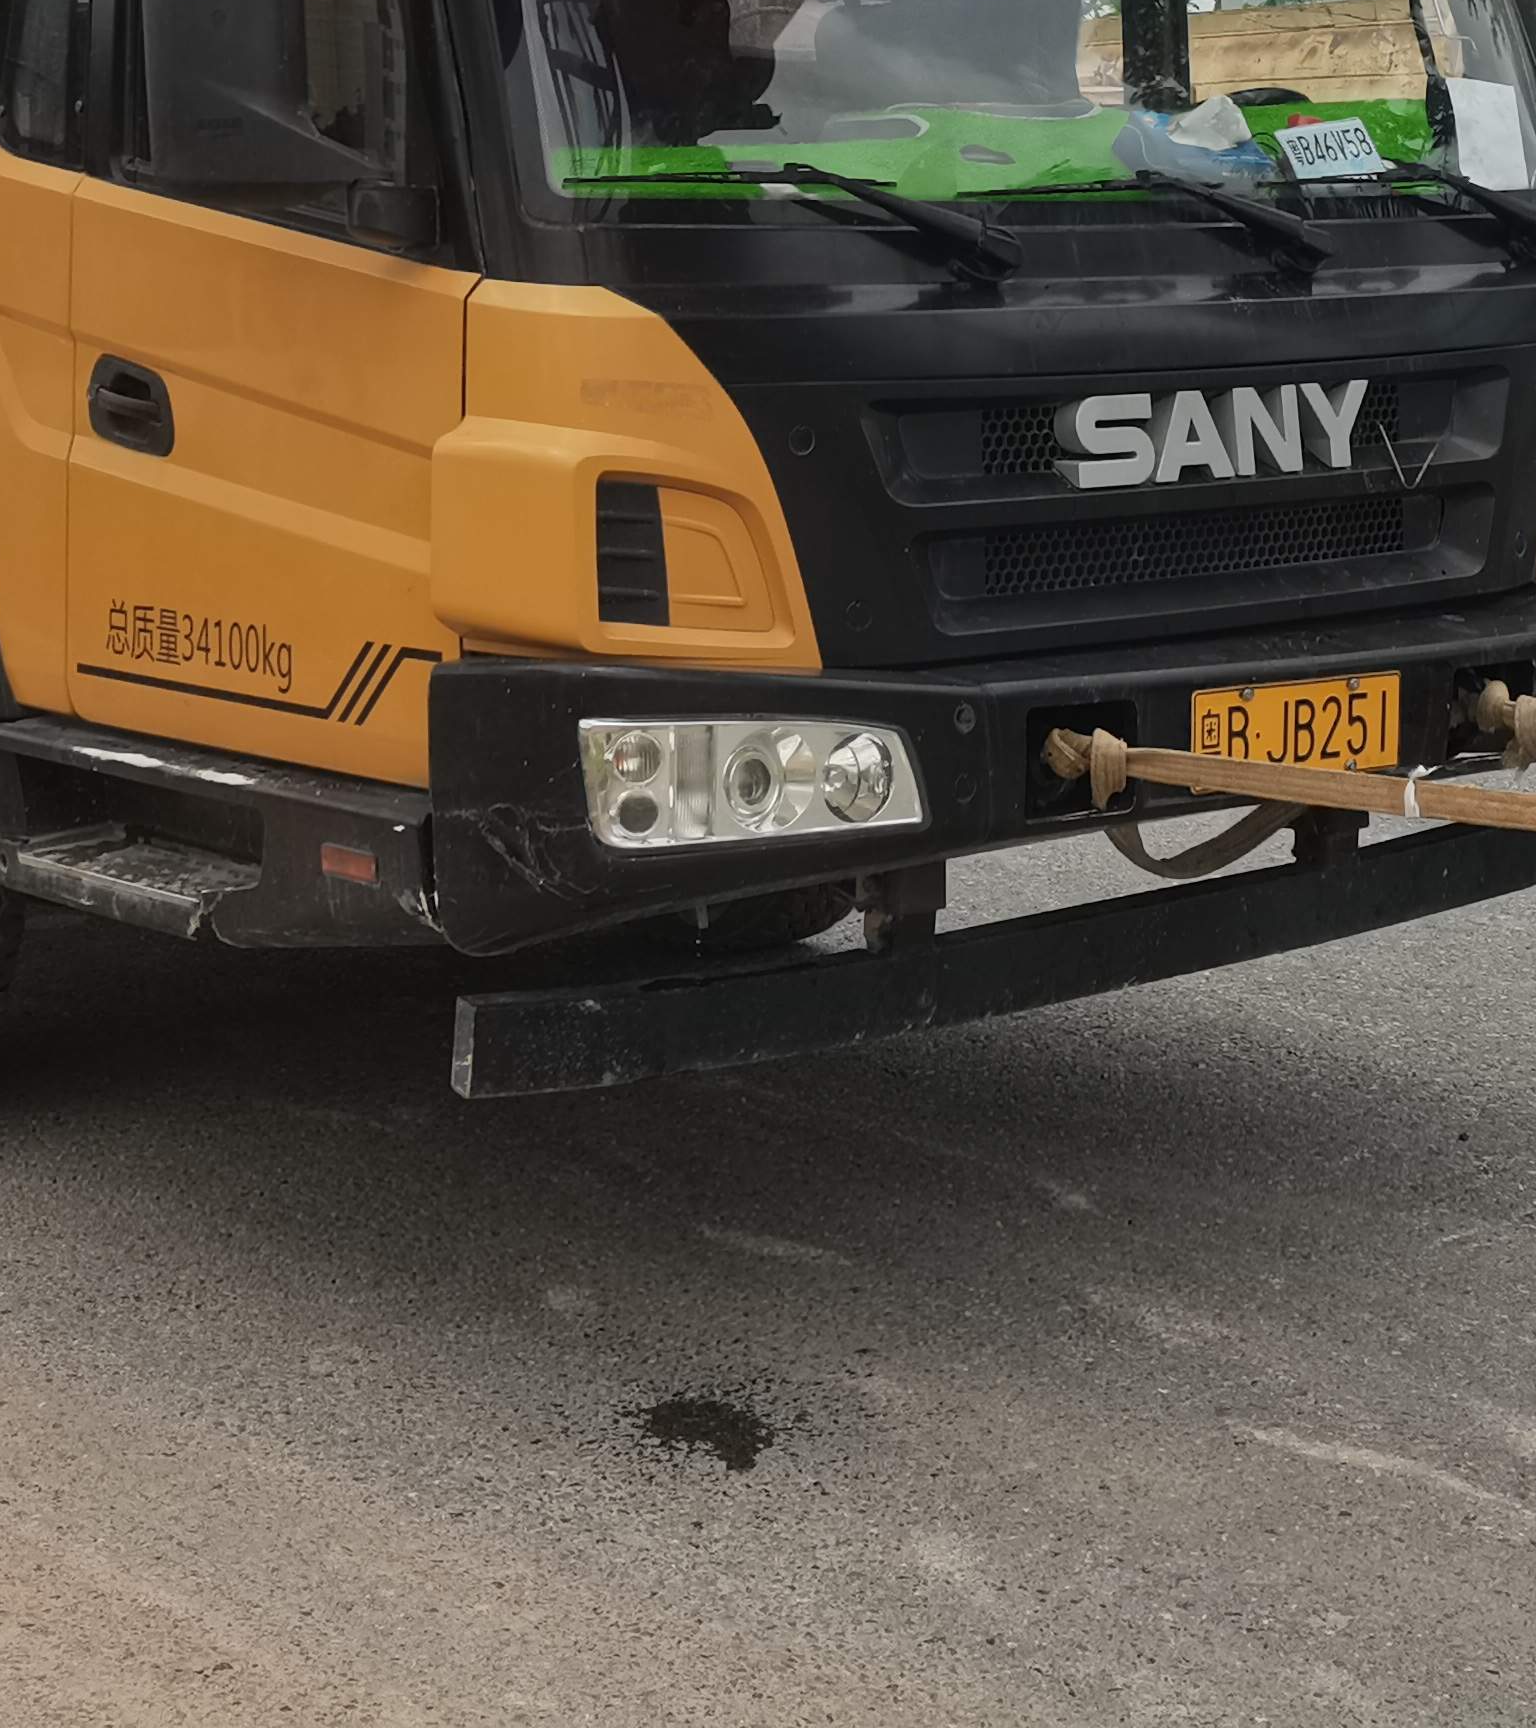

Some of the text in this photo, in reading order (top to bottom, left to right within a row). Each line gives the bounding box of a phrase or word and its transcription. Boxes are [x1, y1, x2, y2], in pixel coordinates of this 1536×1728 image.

[1055, 379, 1369, 490] SANY
[106, 598, 293, 694] 总质量34100kg
